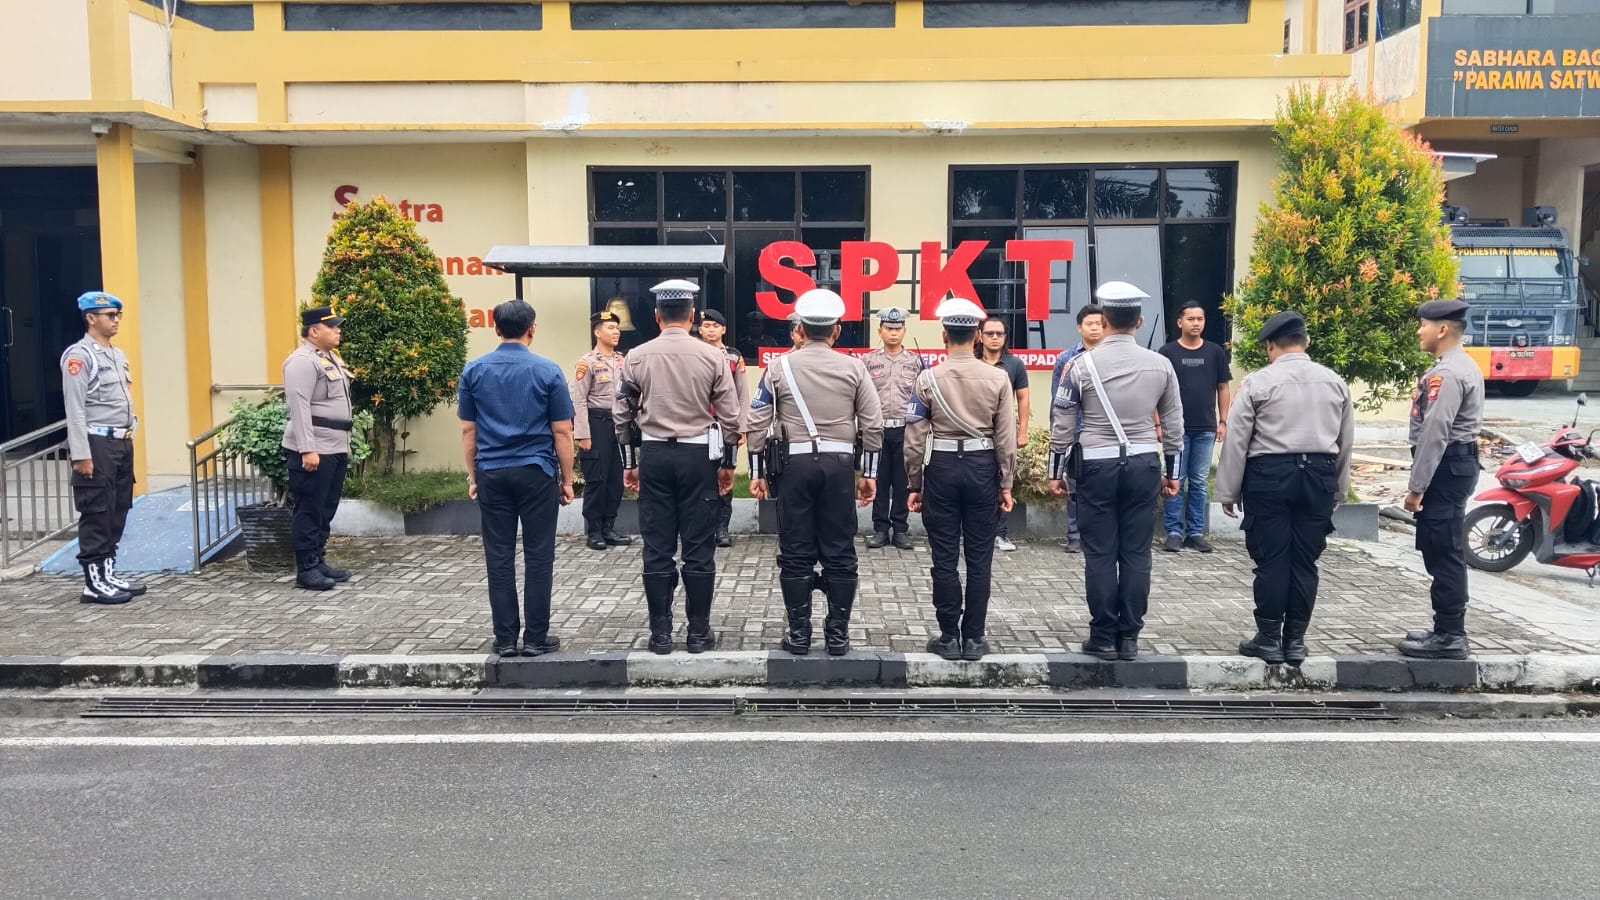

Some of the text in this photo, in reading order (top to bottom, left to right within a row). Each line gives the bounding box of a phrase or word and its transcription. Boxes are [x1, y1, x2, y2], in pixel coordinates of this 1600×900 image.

[1454, 49, 1556, 67] SABHARA
[332, 184, 444, 223] Stra
[755, 239, 1074, 321] SPKT
